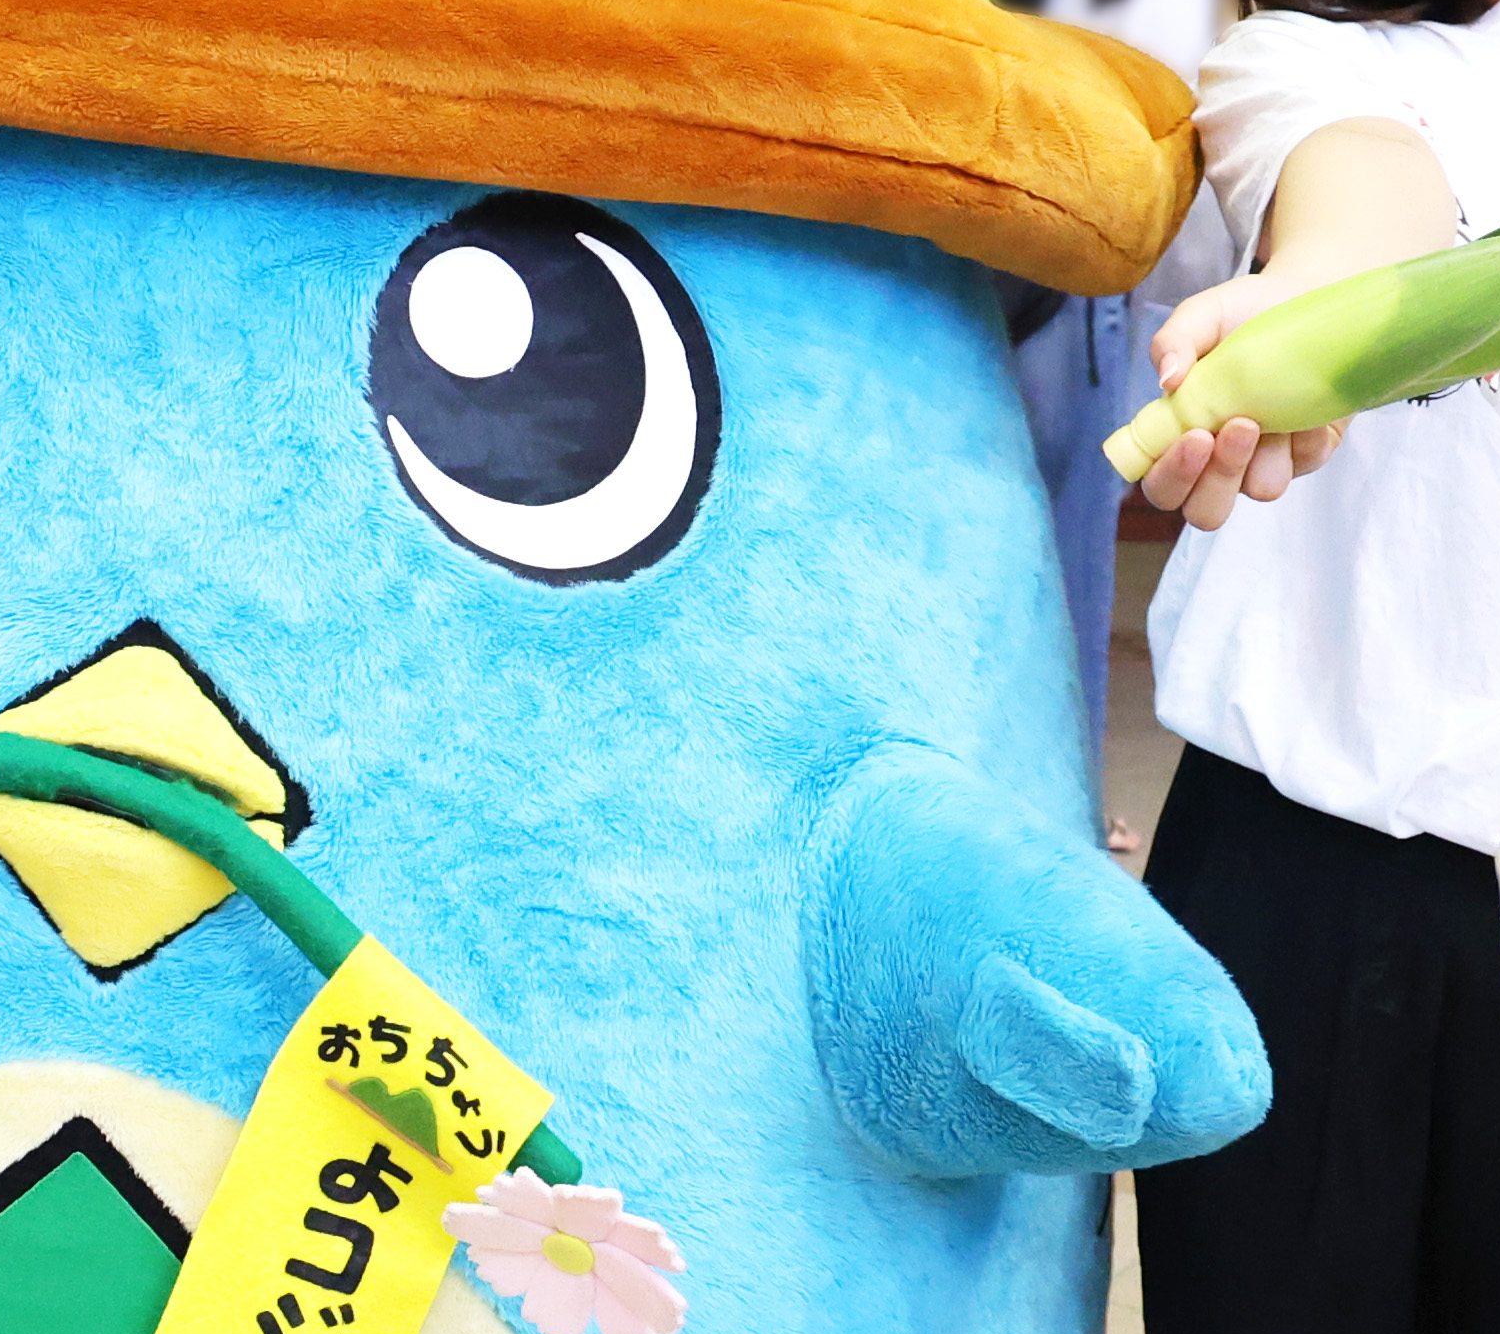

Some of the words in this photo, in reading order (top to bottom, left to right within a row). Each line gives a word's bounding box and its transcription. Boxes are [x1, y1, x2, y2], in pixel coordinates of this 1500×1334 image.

[317, 1015, 506, 1159] おちちょう
